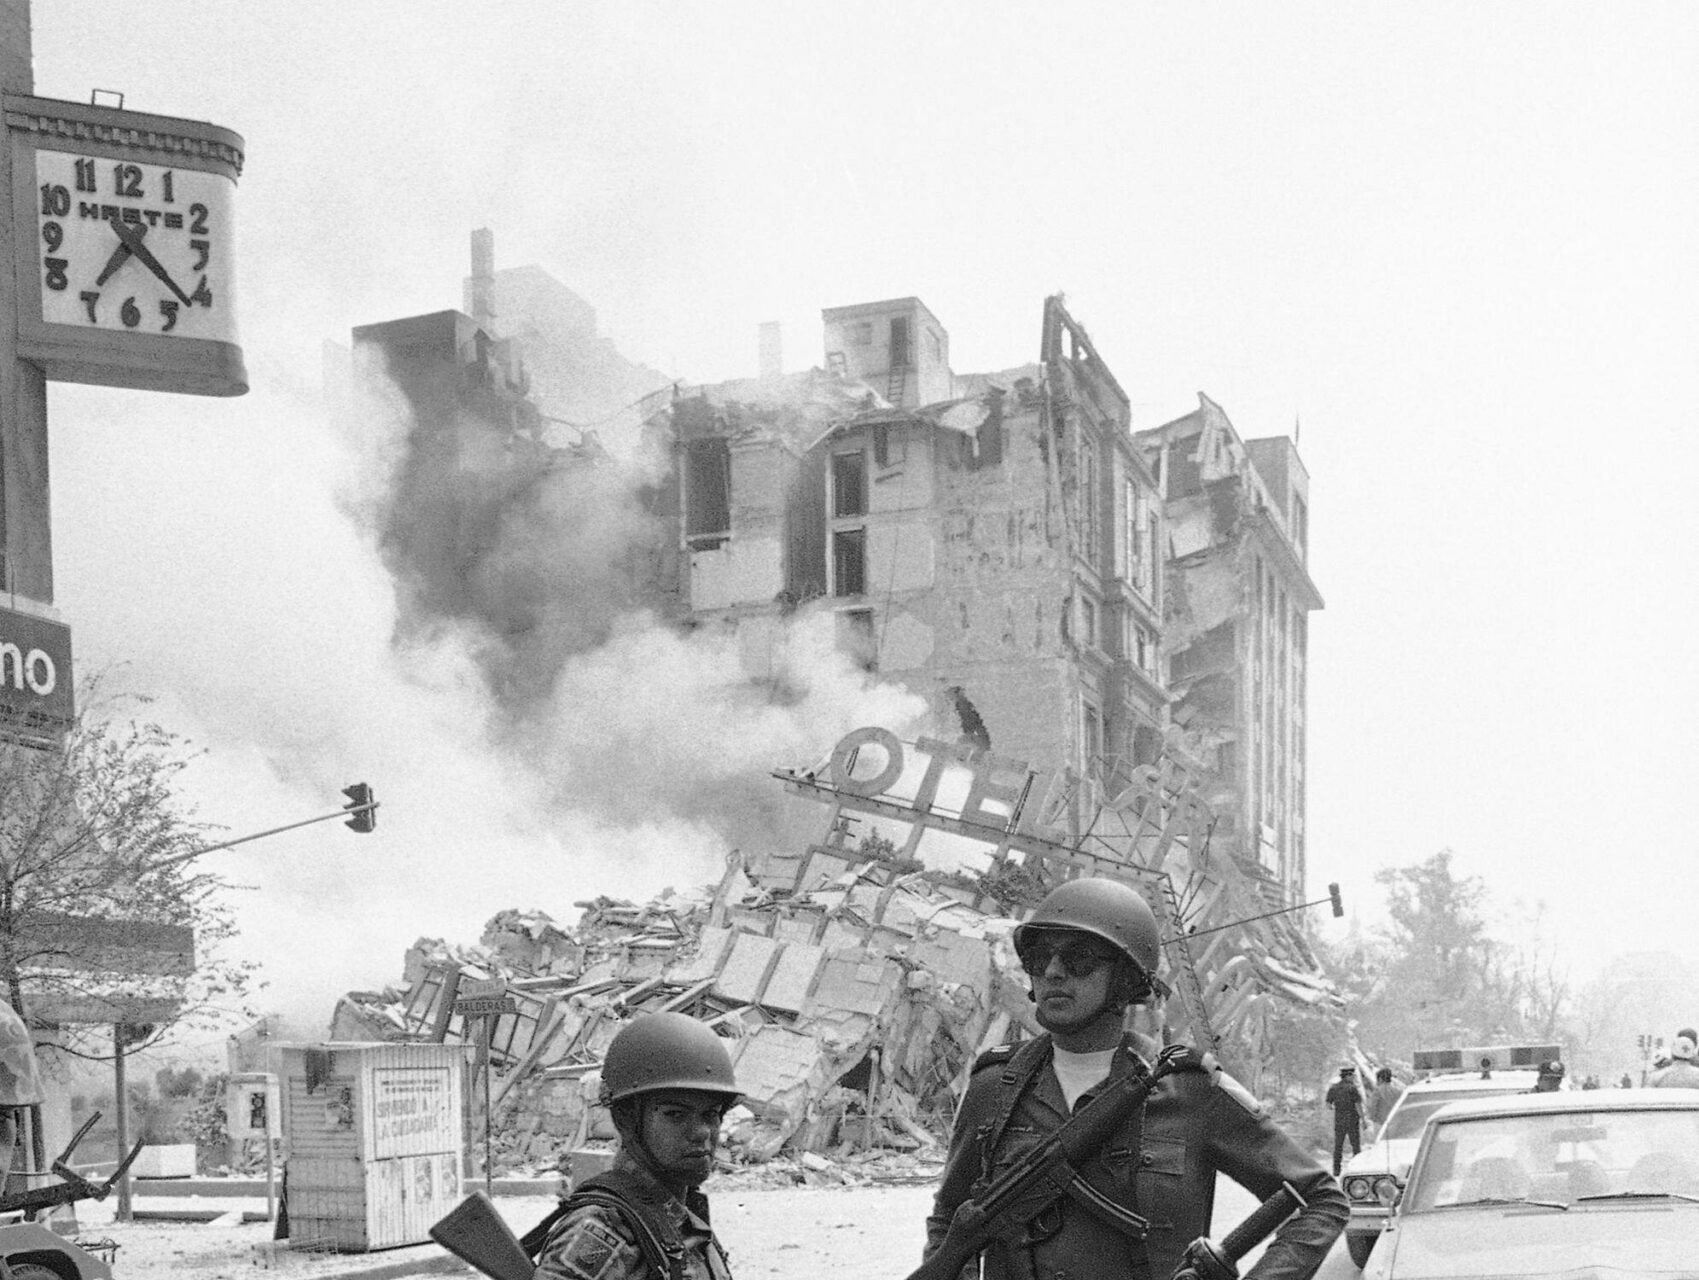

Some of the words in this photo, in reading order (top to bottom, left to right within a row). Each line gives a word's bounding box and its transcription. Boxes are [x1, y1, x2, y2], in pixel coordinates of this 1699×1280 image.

[74, 158, 97, 193] 11
[113, 163, 145, 198] 12
[162, 170, 175, 203] 1
[40, 183, 71, 218] 10
[189, 202, 210, 235] 2
[42, 220, 64, 254] 9
[190, 238, 211, 271] 3
[44, 256, 69, 291] 8
[79, 290, 101, 324] 7
[191, 274, 213, 308] 4
[120, 296, 142, 328] 6
[160, 299, 180, 332] 5
[457, 1000, 507, 1013] BALDERAS
